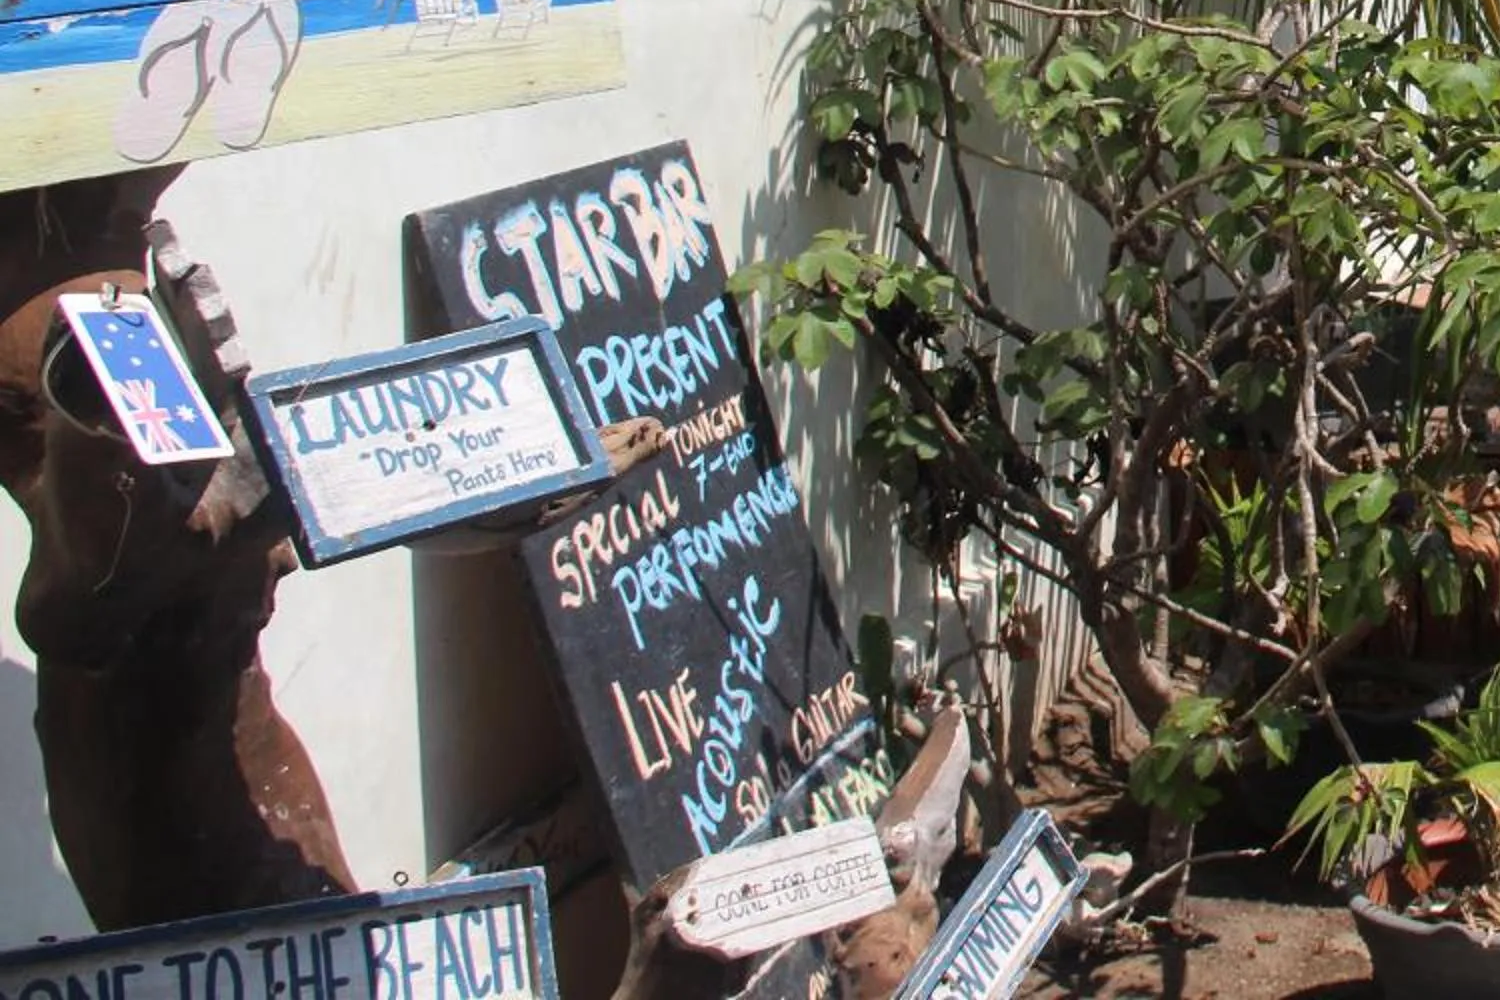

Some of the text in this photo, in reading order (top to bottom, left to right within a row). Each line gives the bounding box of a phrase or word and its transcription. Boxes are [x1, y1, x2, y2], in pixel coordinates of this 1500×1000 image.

[291, 358, 509, 455] LAUNDRY
[577, 298, 737, 424] PRESENT
[447, 449, 556, 496] Pants Here
[448, 425, 505, 458] Your
[611, 668, 705, 781] LIVE
[770, 870, 811, 906] FOR
[813, 854, 879, 893] COFFEE
[246, 927, 350, 1000] THE
[361, 902, 524, 1000] BEACH
